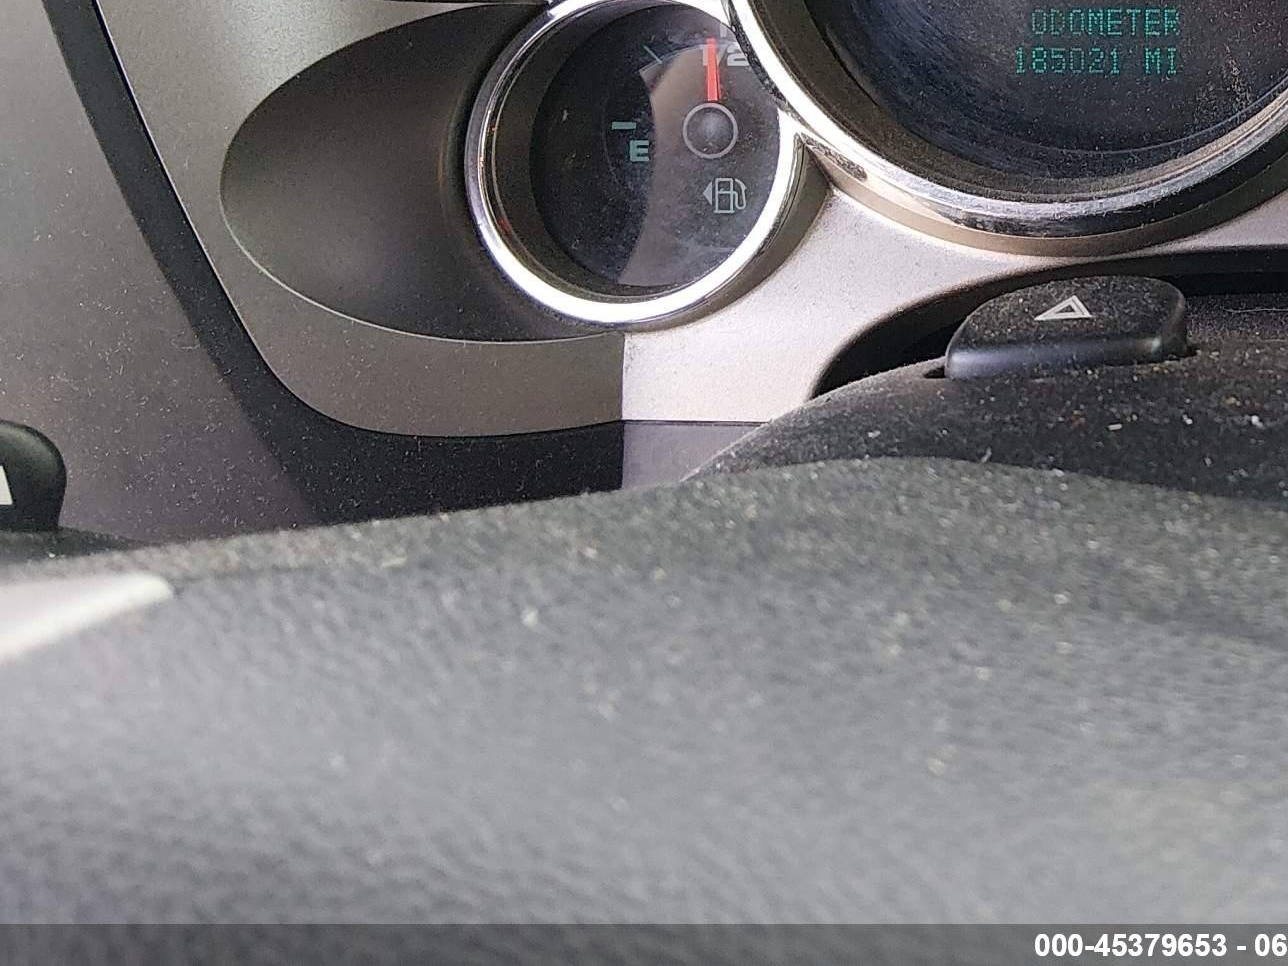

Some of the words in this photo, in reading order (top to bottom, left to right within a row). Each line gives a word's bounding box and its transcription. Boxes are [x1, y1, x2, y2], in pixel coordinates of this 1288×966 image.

[1032, 9, 1181, 35] ODOMETER
[1015, 47, 1120, 74] 185021
[1145, 47, 1177, 75] MI
[630, 140, 649, 163] E
